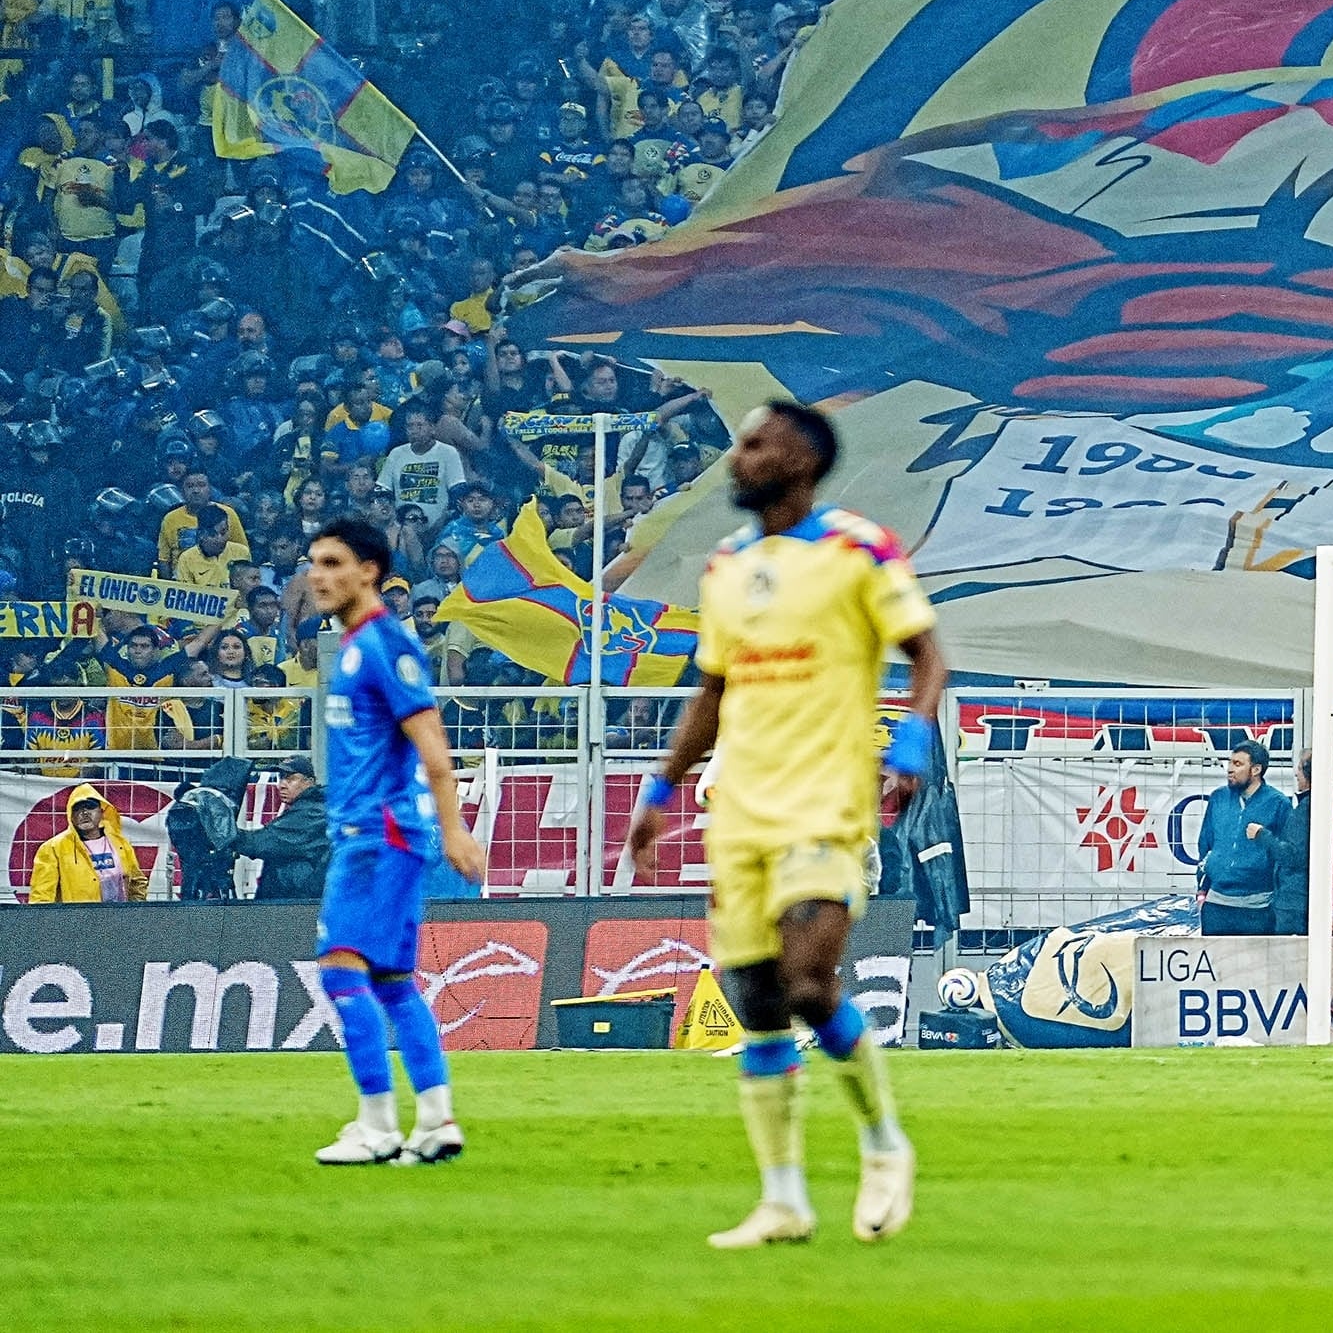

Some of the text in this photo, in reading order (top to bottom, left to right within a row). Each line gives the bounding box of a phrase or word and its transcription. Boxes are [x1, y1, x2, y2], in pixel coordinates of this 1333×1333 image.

[79, 575, 95, 597] EL
[164, 587, 228, 619] GRANDE
[1140, 949, 1216, 982] LIGA
[714, 998, 736, 1027] CUIDADO
[705, 1029, 729, 1037] CAUTION
